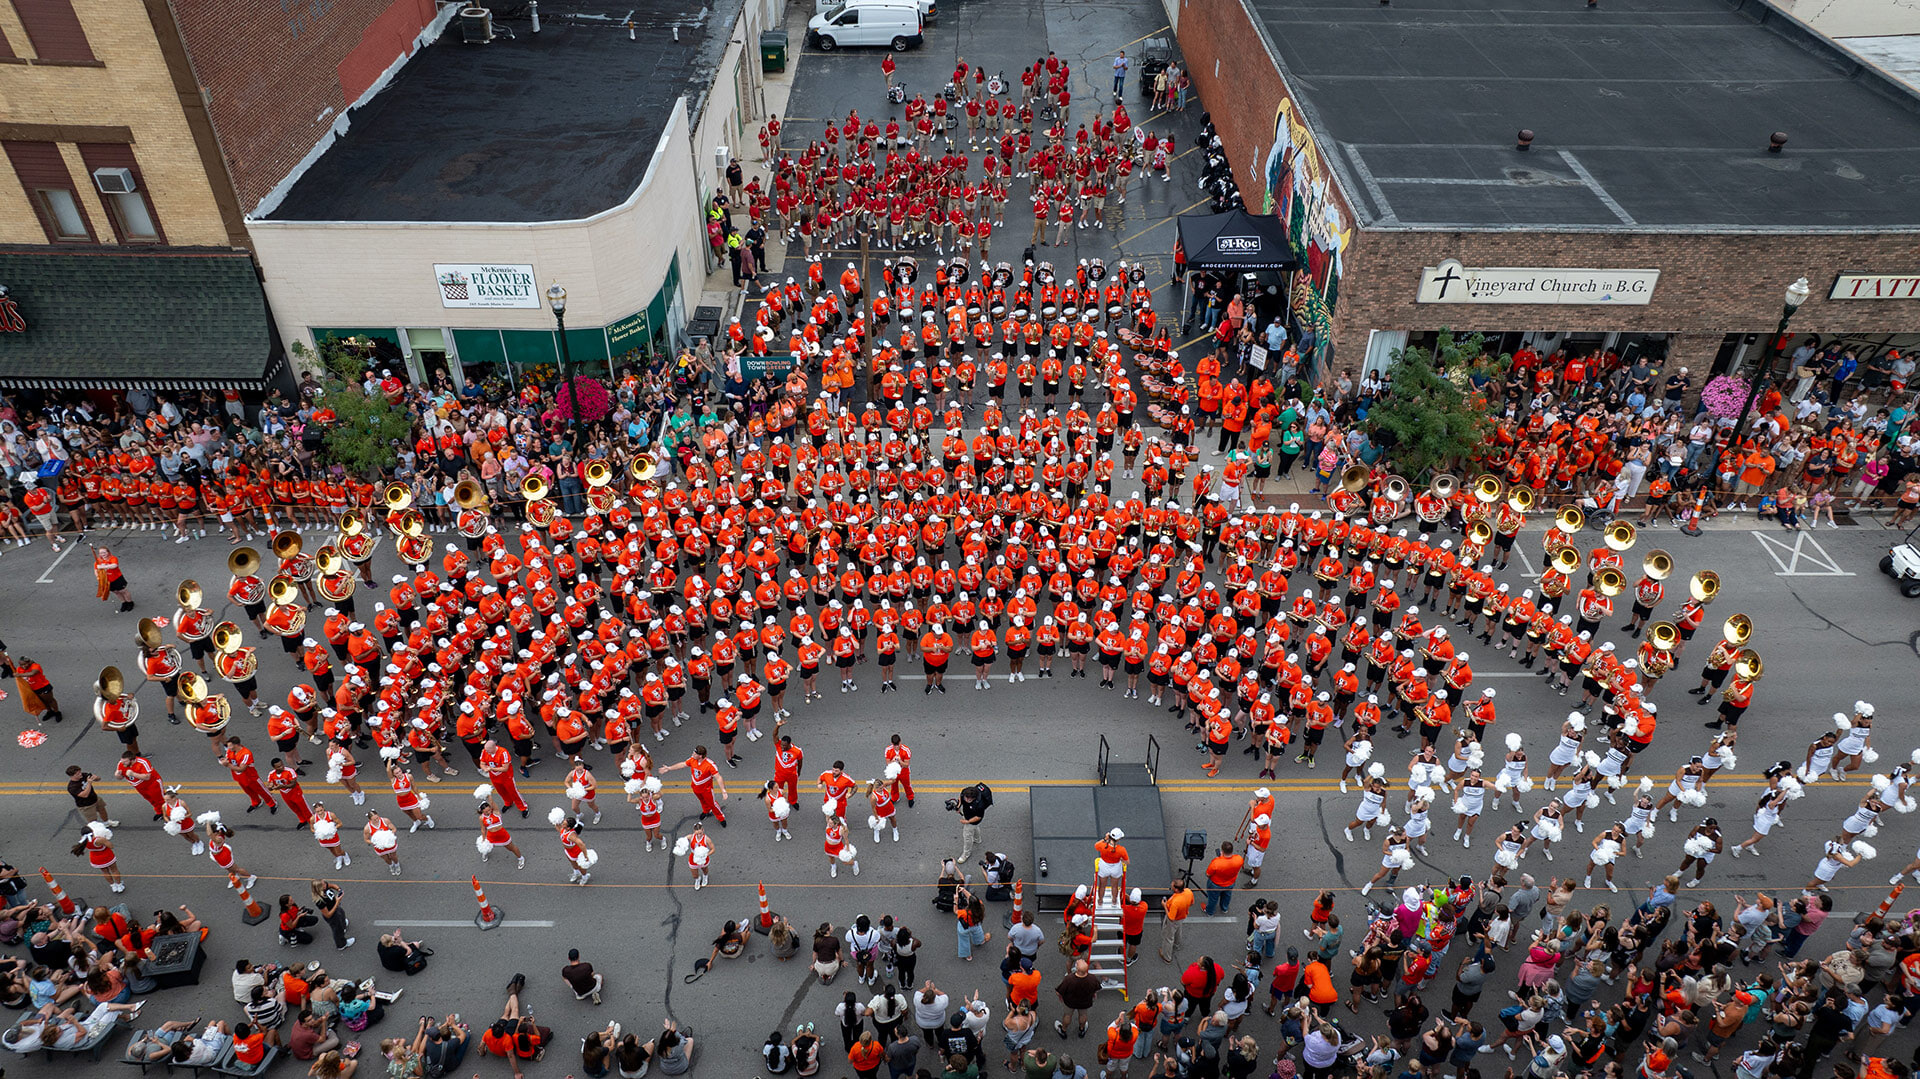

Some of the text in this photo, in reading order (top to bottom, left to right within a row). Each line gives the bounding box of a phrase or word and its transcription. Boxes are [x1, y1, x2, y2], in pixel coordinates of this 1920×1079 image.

[471, 273, 531, 284] FLOWER
[477, 285, 530, 296] BASKET
[1465, 279, 1647, 295] Vineyard Church in B.G.
[612, 325, 646, 343] Flower Basket
[613, 318, 642, 334] McKenzie's
